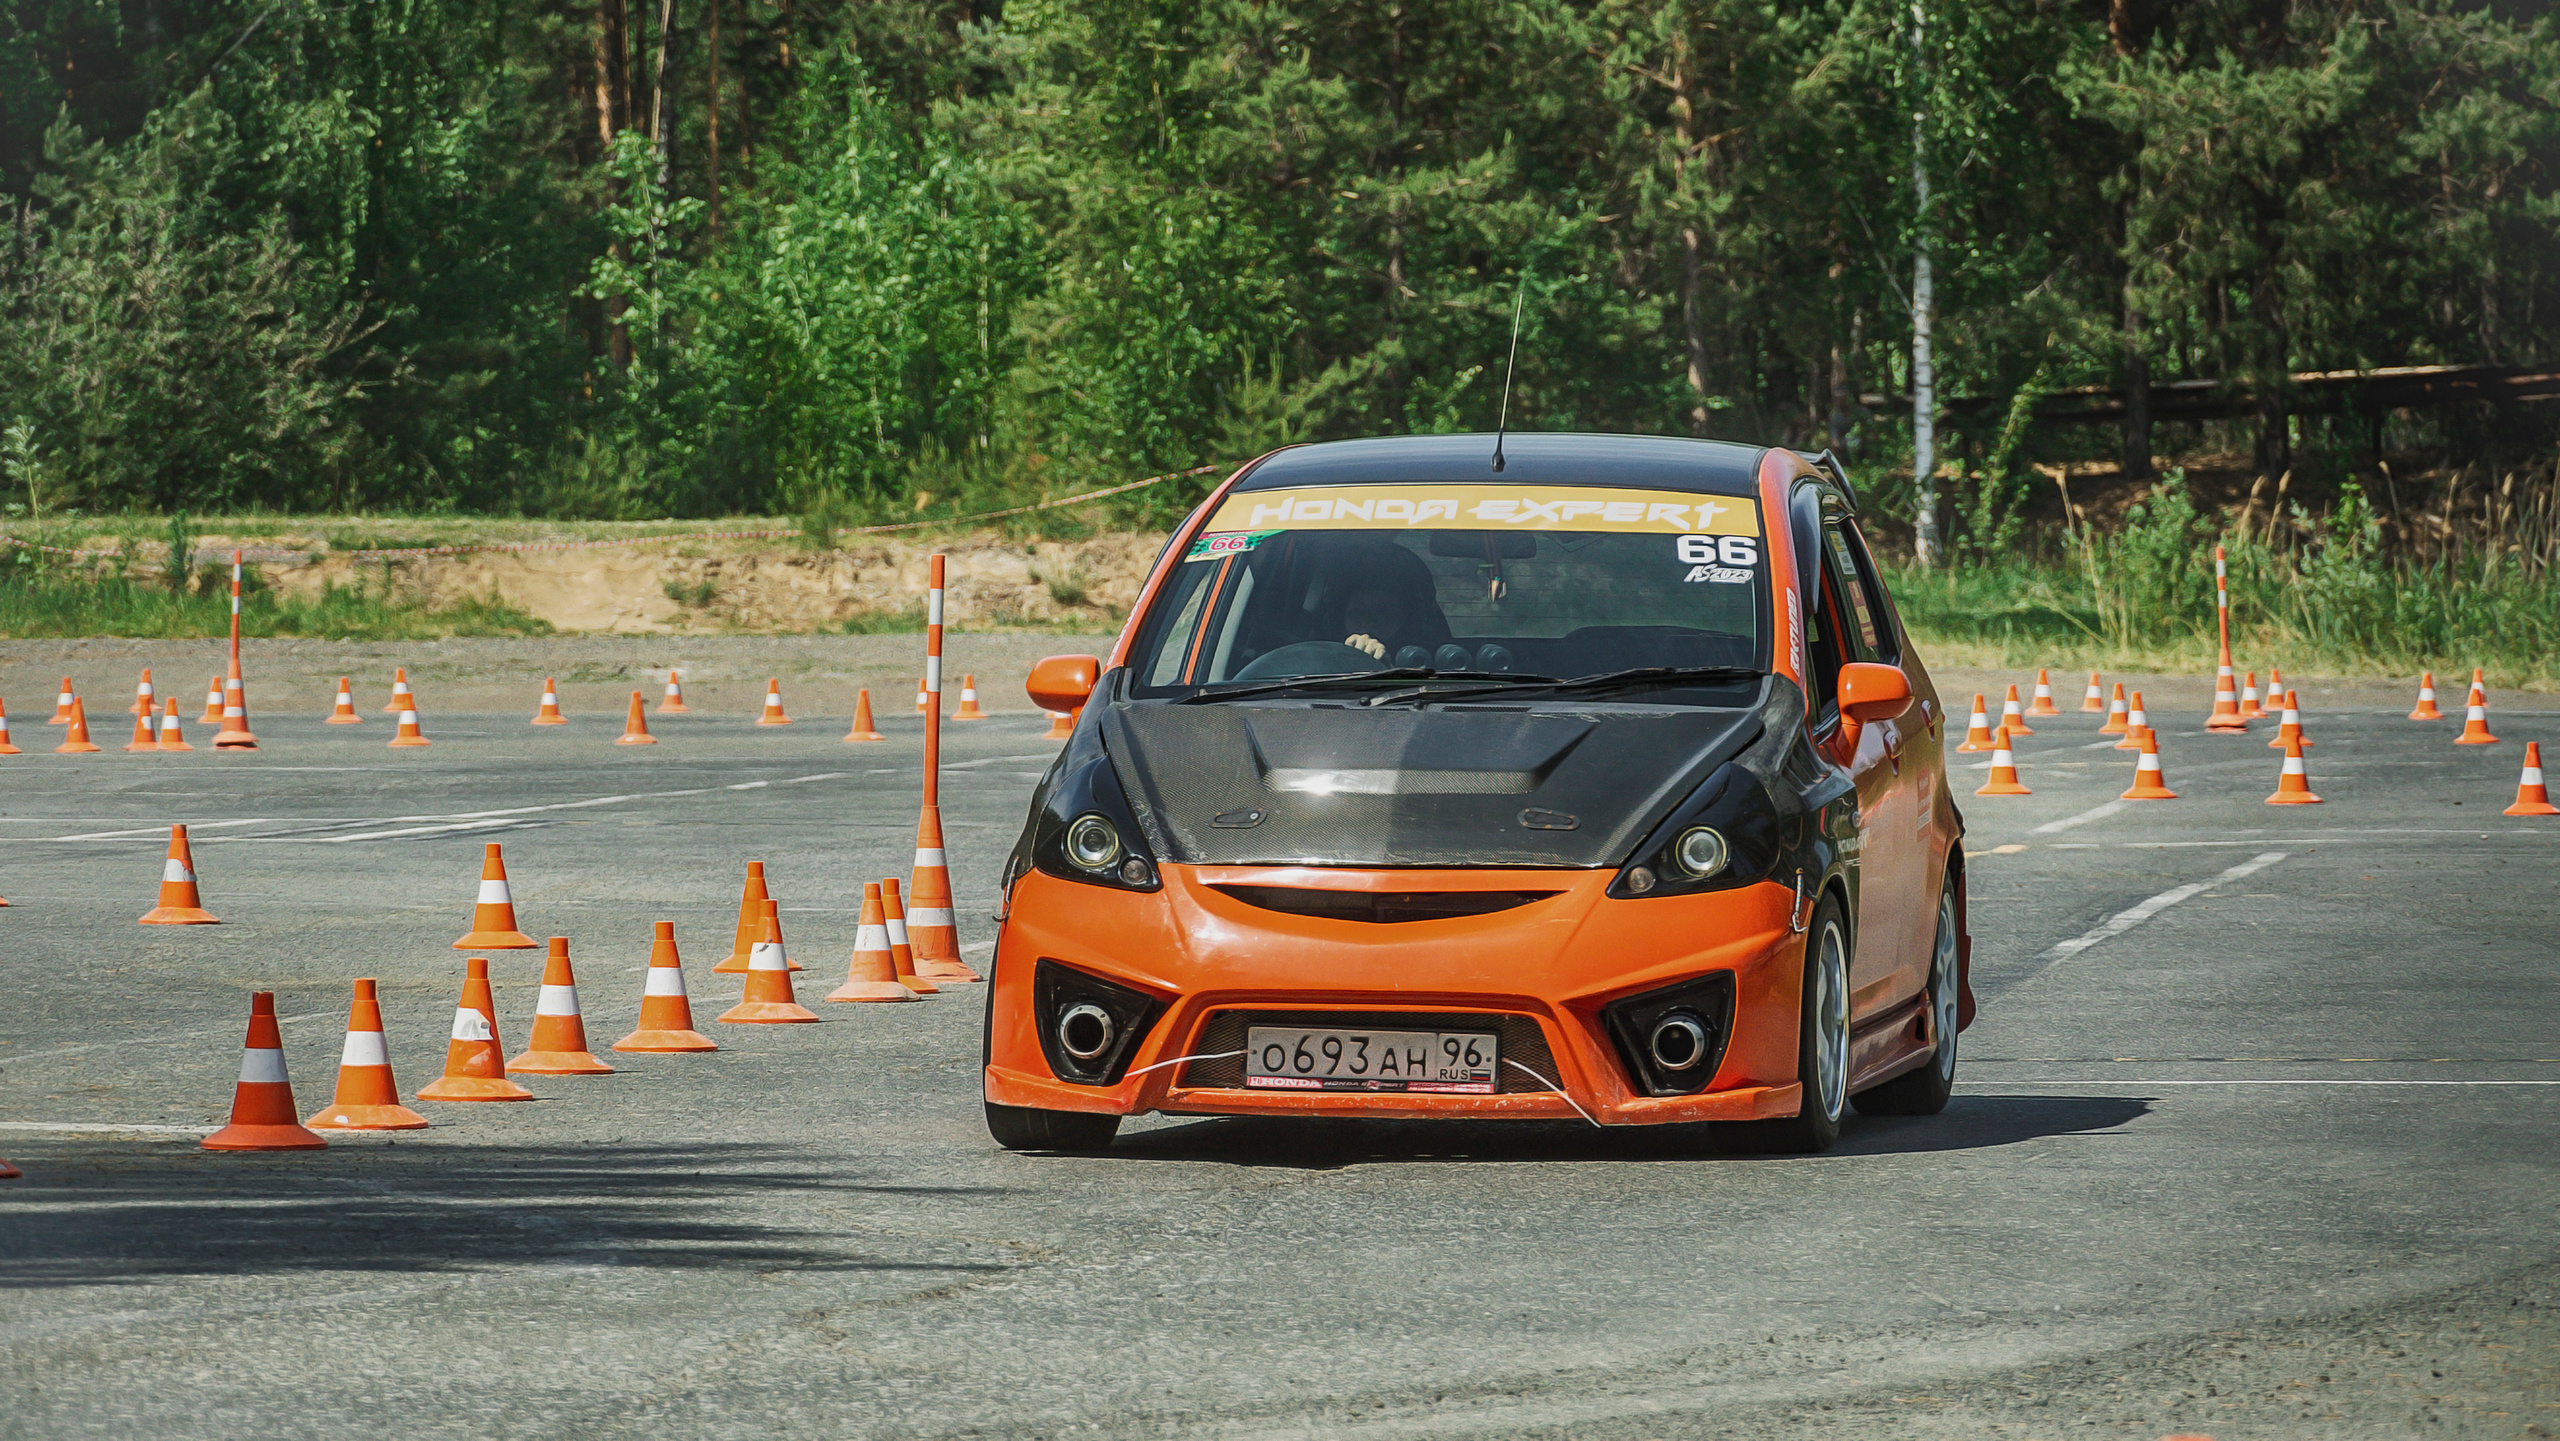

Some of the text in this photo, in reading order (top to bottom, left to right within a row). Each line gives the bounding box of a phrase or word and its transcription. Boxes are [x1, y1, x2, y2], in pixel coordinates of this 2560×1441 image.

[1249, 496, 1459, 528] HONDA
[1209, 536, 1248, 551] 66
[1676, 534, 1758, 566] 66
[1443, 1037, 1482, 1067] 96
[1261, 1077, 1322, 1087] HONDA
[1439, 1068, 1469, 1080] RUS
